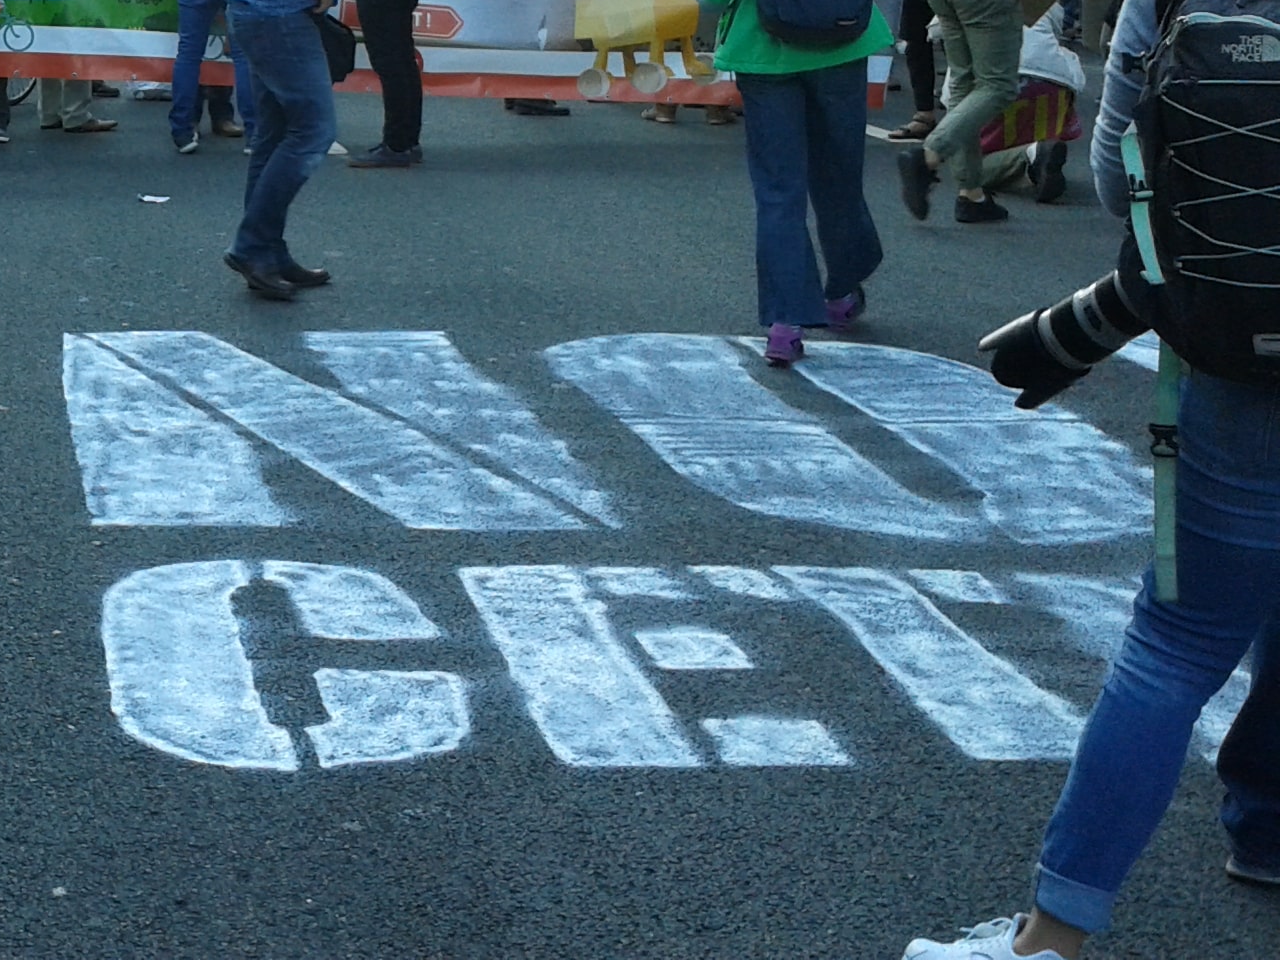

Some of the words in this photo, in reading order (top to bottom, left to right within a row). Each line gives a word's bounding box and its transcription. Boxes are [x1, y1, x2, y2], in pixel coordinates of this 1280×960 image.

[1238, 35, 1262, 45] THE
[1220, 43, 1262, 54] NORTH
[1232, 53, 1261, 63] FACE
[62, 330, 1160, 548] NO
